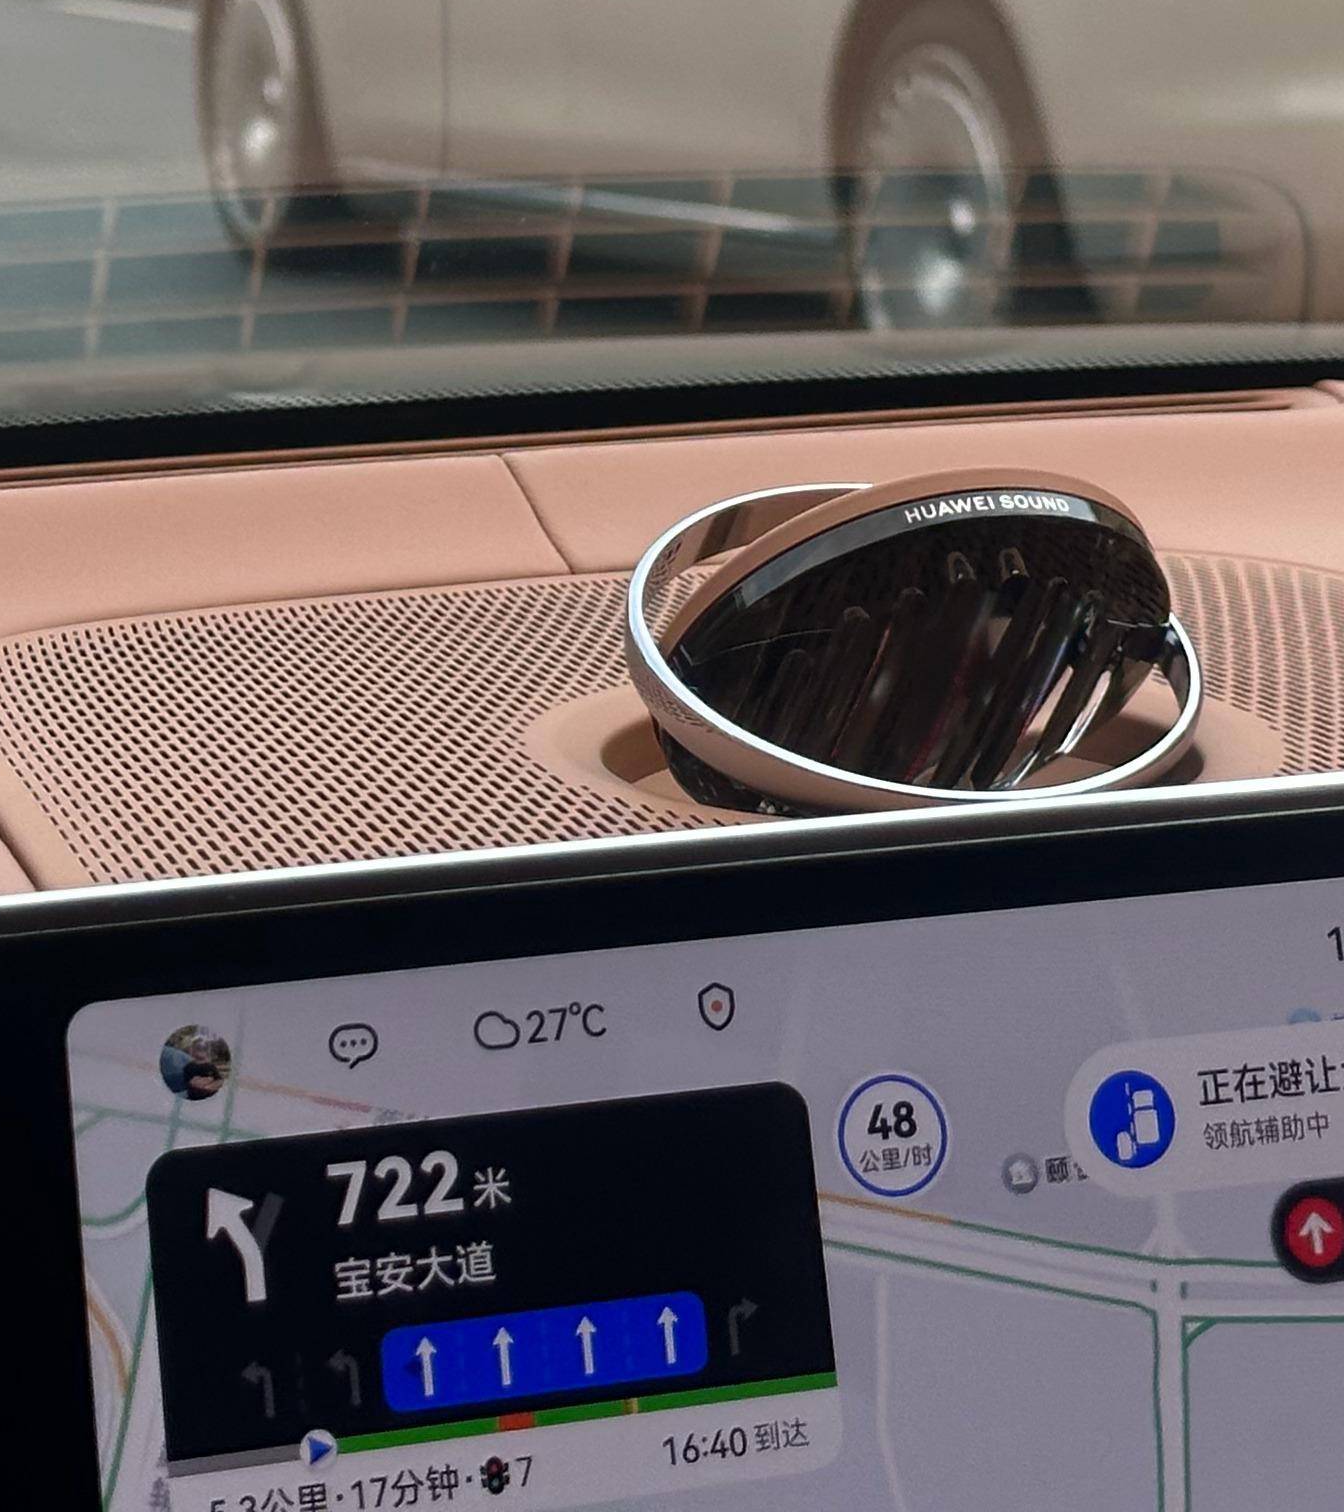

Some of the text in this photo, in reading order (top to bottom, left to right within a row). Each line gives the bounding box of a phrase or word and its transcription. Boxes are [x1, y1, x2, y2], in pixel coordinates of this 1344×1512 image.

[904, 493, 1070, 524] HUAWEI SOUND
[867, 1100, 918, 1140] 48
[1203, 1110, 1330, 1151] 领航辅助中
[859, 1143, 934, 1174] 公里/时
[334, 1239, 497, 1300] 宝安大道
